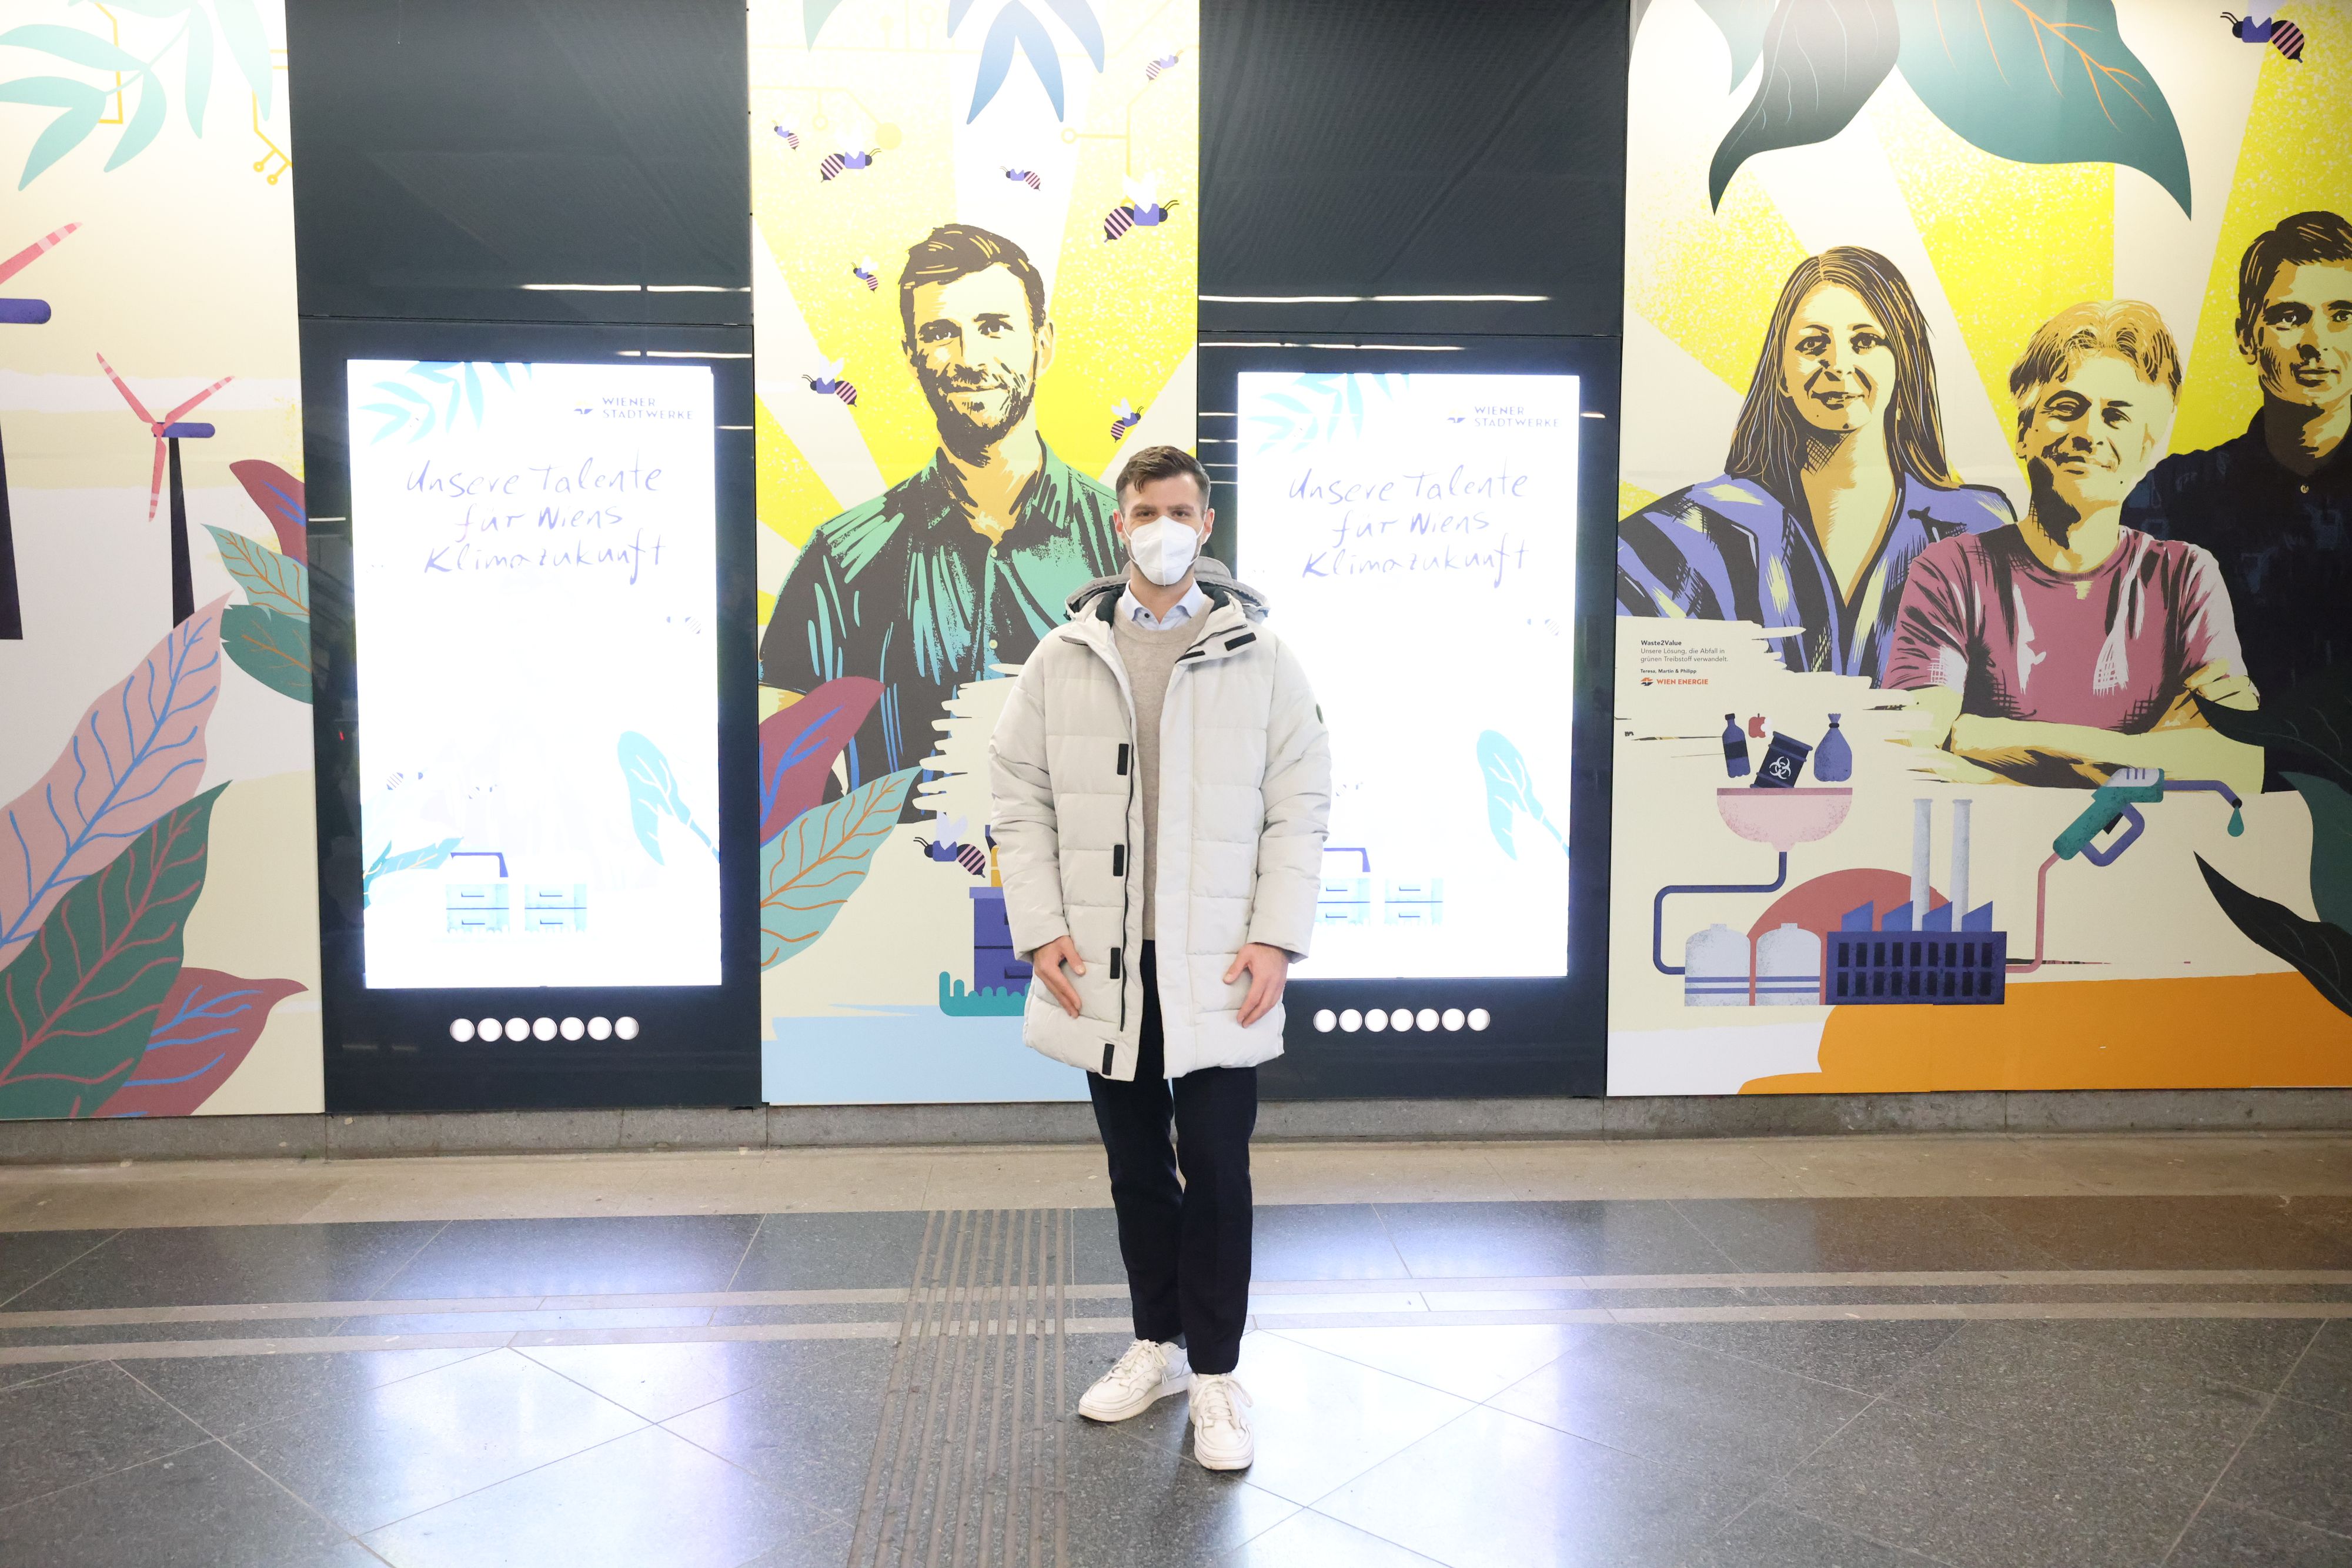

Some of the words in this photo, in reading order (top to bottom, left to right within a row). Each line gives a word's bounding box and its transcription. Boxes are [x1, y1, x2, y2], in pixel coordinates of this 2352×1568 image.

[602, 397, 656, 407] WIENER
[602, 409, 694, 420] STADTWERKE
[1474, 406, 1525, 416] WIENER
[1474, 417, 1559, 427] STADTWERKE
[406, 459, 520, 498] Unsere
[527, 449, 663, 494] Talente
[1288, 467, 1395, 504] Unsere
[1402, 457, 1528, 501] Talente
[537, 505, 623, 533] Wiens
[1409, 510, 1490, 536] Wiens
[423, 527, 667, 586] Klimazukunft
[1301, 532, 1529, 589] Klimazukunft
